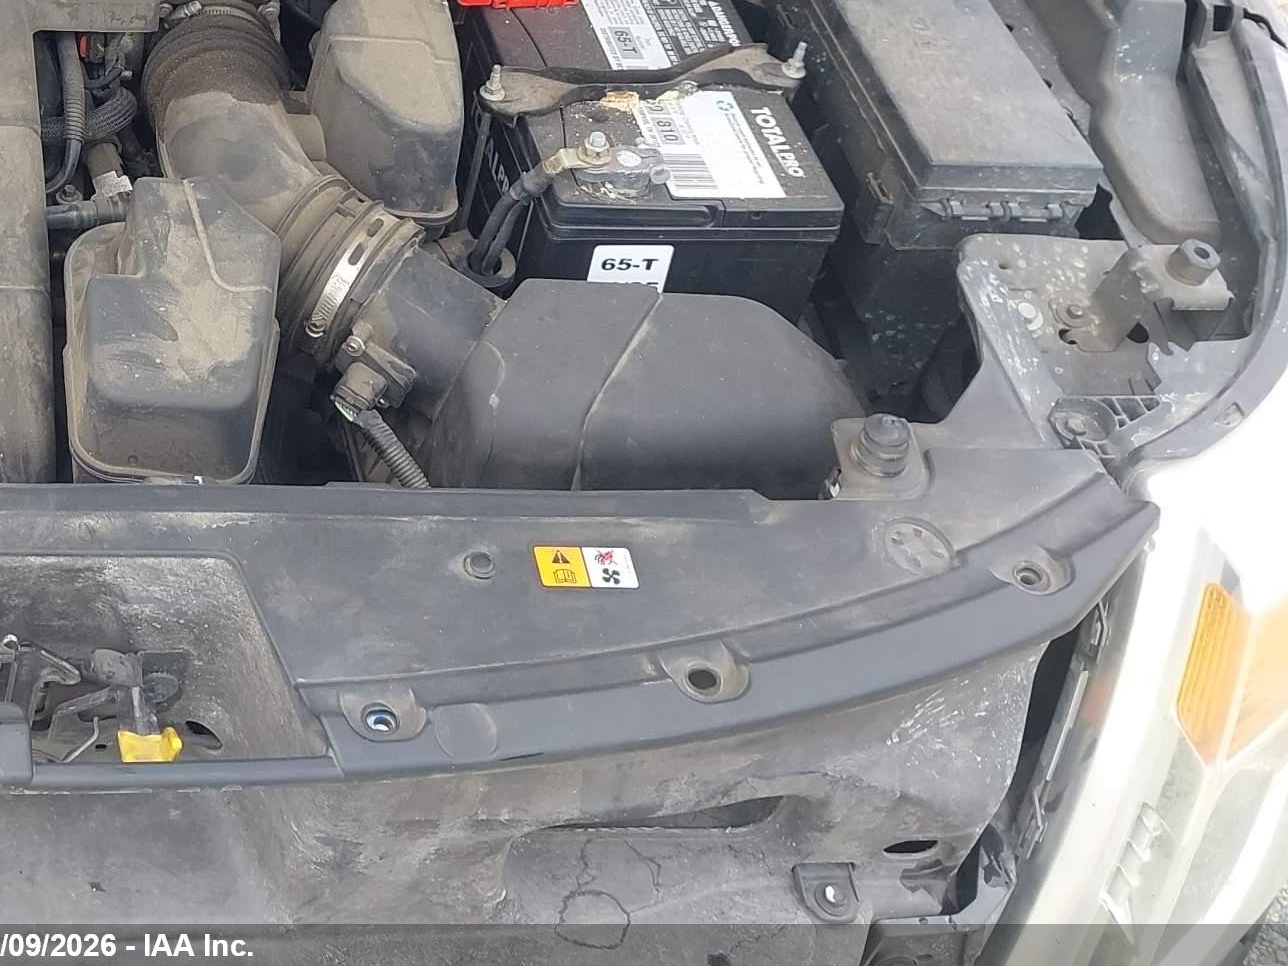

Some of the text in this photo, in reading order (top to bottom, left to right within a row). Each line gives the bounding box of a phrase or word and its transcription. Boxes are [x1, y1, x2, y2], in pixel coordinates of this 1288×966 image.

[614, 30, 638, 54] 65-T
[656, 120, 679, 142] 810
[749, 106, 805, 178] TOTALPRO
[601, 258, 659, 271] 65-T
